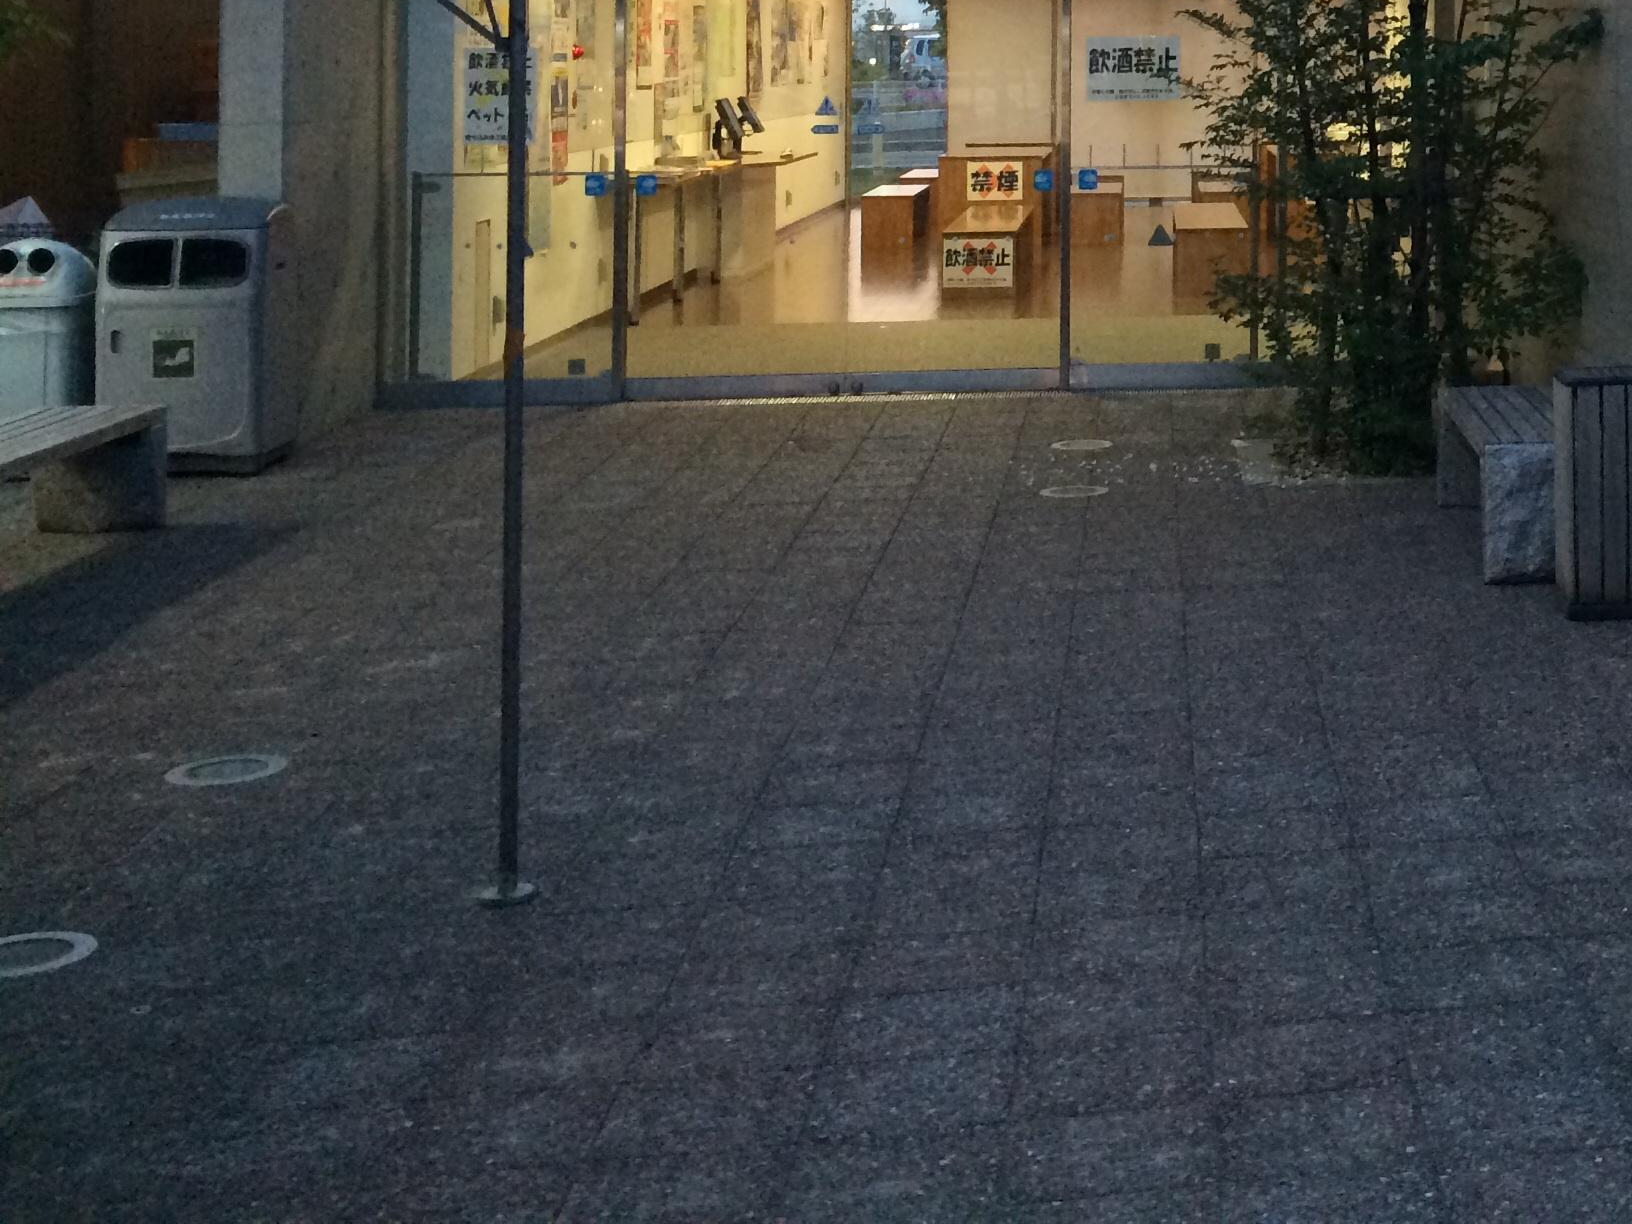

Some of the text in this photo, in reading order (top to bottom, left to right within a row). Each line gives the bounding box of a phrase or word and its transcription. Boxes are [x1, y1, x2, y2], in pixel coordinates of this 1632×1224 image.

[1089, 47, 1178, 74] 飲酒禁止
[970, 171, 1018, 192] 禁煙
[945, 248, 1010, 267] 飲酒禁止
